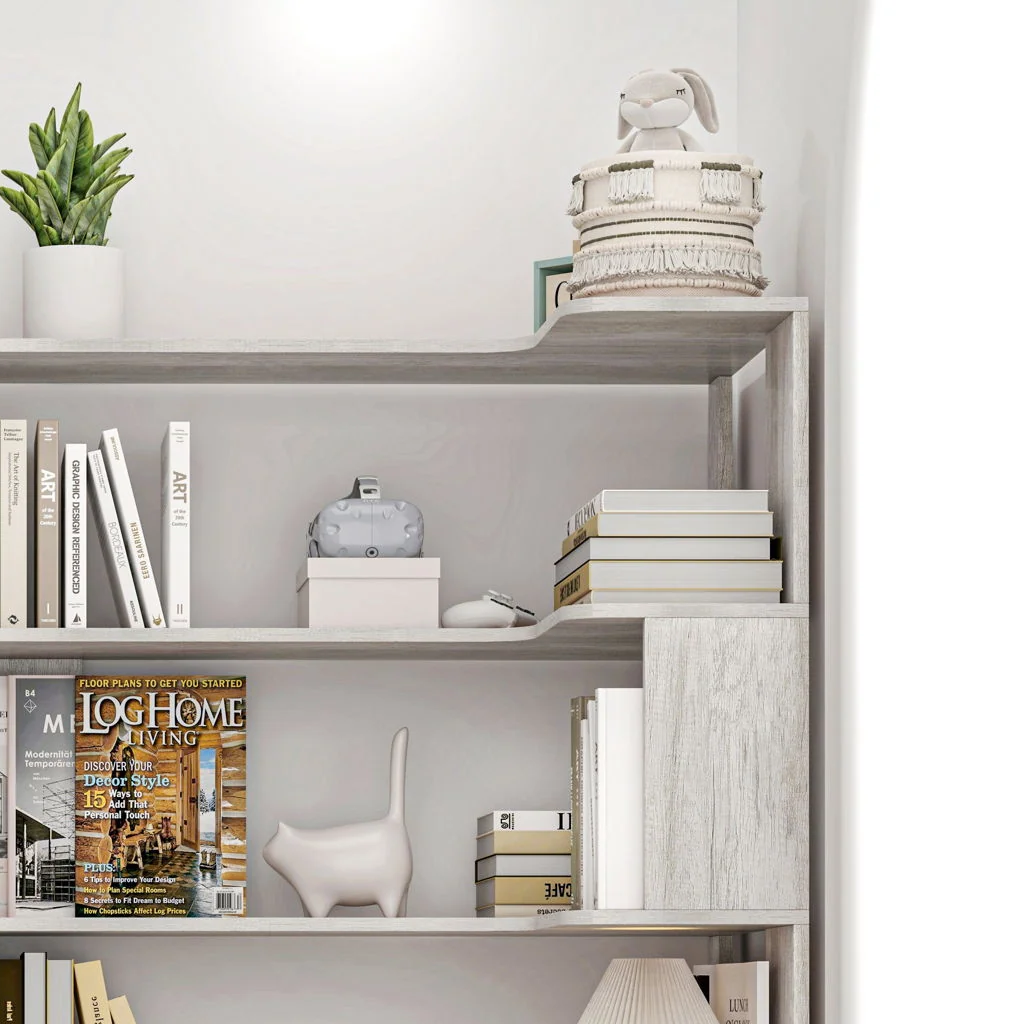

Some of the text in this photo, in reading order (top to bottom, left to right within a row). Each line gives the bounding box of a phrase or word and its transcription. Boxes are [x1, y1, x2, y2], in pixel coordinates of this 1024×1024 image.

[173, 471, 187, 503] ART
[72, 460, 80, 594] GRAPHIC DESIGN REFERENCED
[80, 679, 243, 688] FLOOR PLANS TO GET YOU STARTED
[128, 730, 197, 746] LIVING
[84, 761, 153, 771] DISCOVER YOUR
[84, 774, 170, 790] Decor Style
[84, 790, 106, 808] 15
[109, 790, 131, 799] Ways
[109, 800, 148, 808] Add That
[84, 811, 150, 819] Personal Touch
[84, 864, 115, 872] PLUS:
